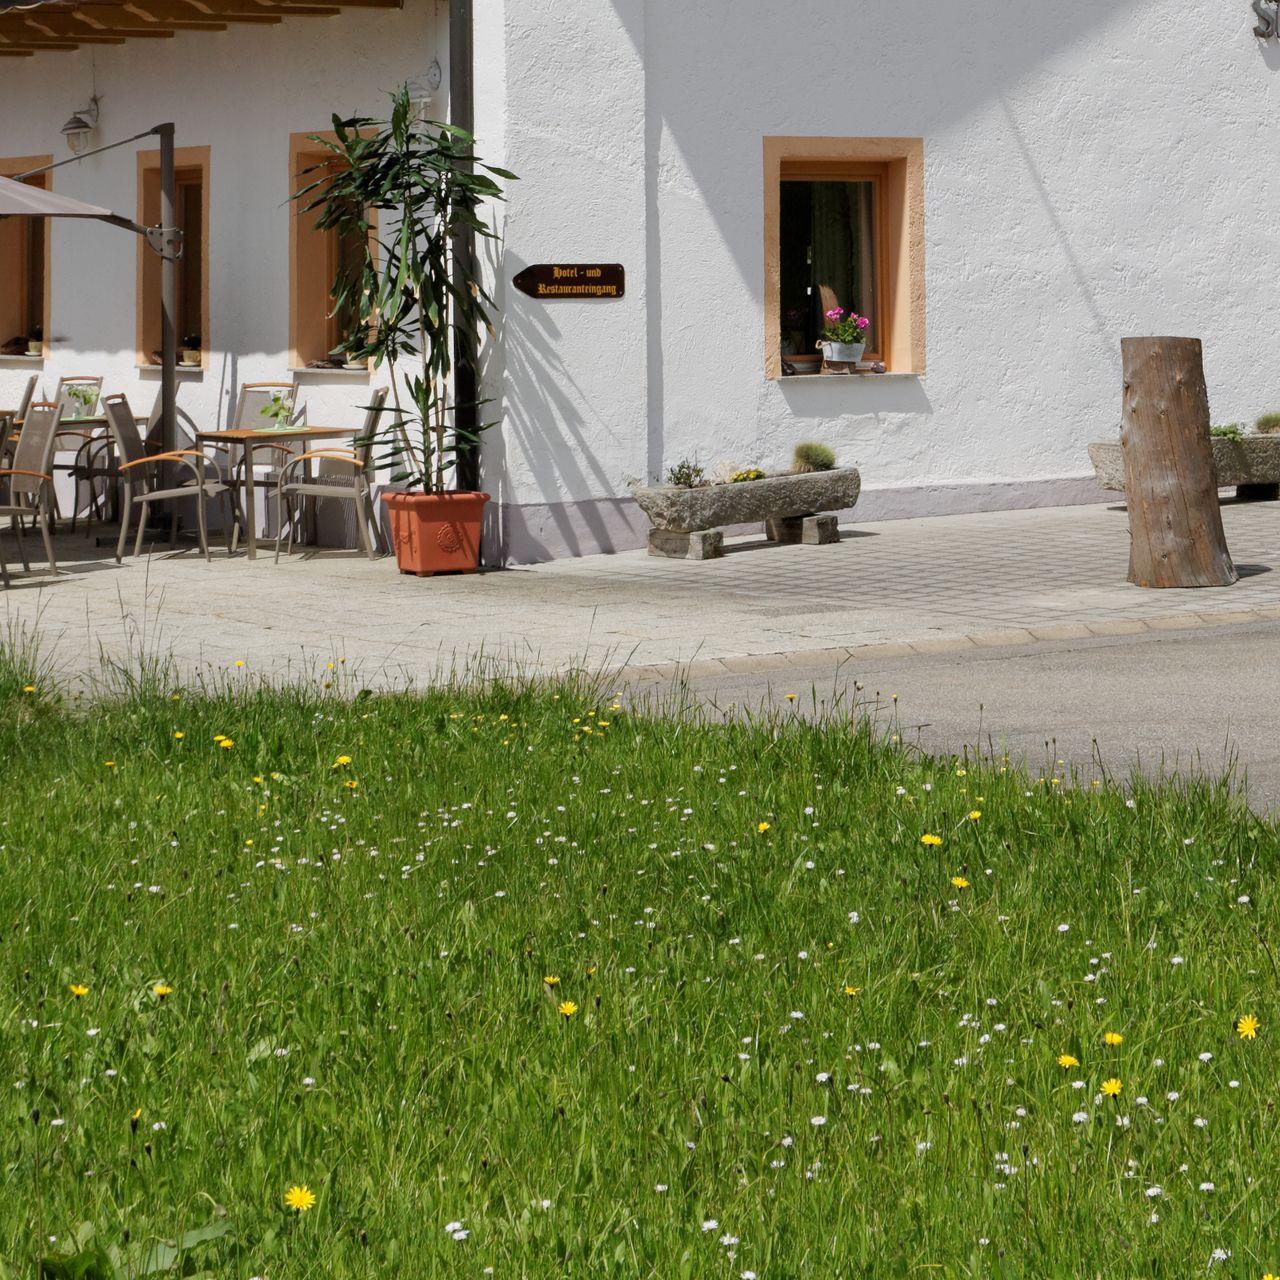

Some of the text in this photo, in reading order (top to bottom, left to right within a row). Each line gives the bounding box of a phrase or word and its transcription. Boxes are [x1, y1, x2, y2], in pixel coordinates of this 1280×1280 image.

[552, 266, 578, 279] Hotel
[586, 267, 602, 278] und
[537, 283, 617, 296] Restauranteingang
